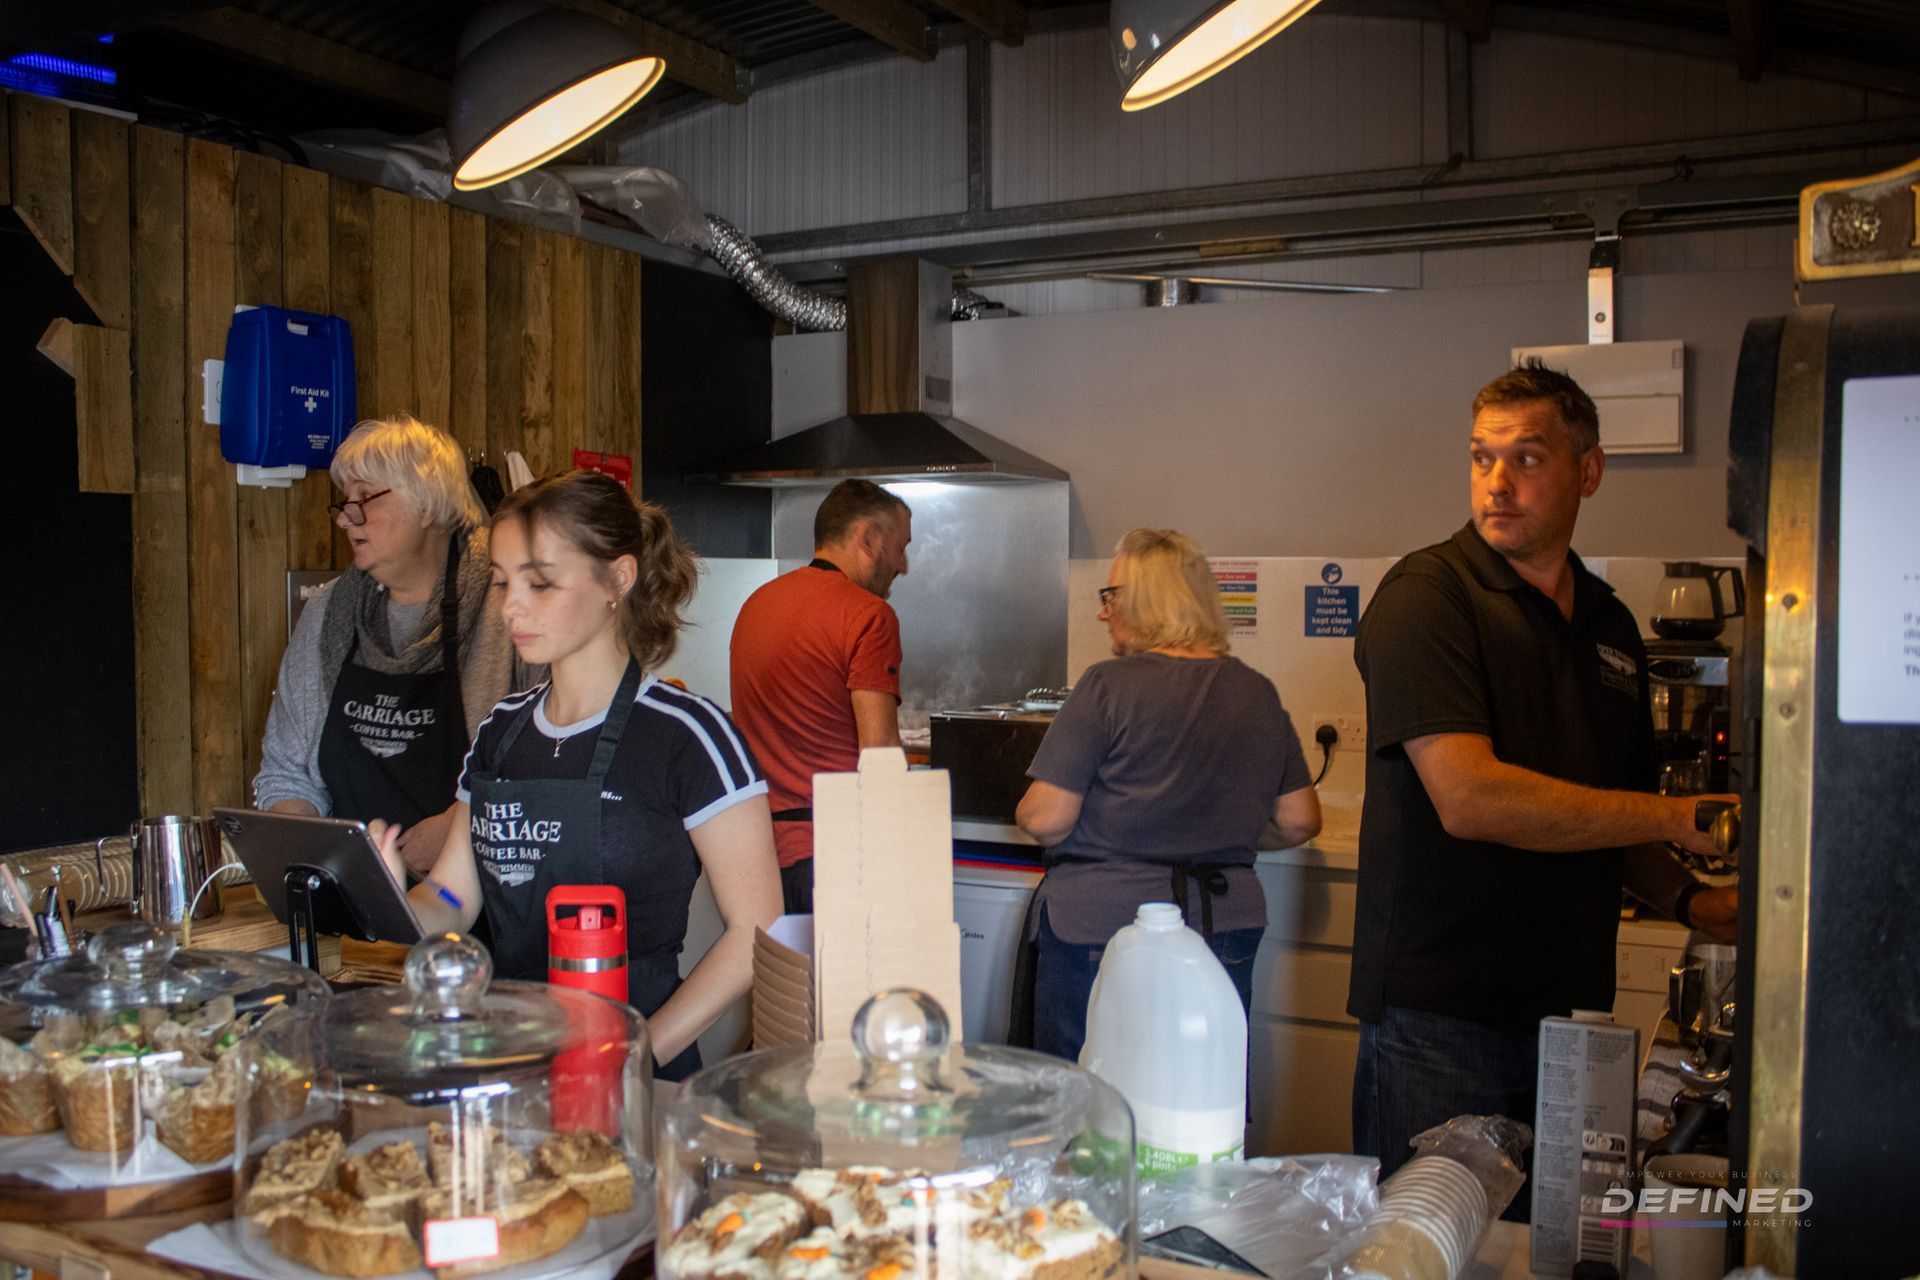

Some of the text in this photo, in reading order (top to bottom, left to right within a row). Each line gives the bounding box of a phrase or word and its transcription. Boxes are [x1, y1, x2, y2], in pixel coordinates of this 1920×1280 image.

[291, 386, 330, 398] First Aid Kit
[1317, 597, 1347, 605] kitchen
[1316, 607, 1348, 615] must be
[1312, 617, 1329, 625] kept
[1316, 626, 1348, 636] and tidy
[375, 694, 400, 708] THE
[343, 700, 436, 726] CARRIAGE
[353, 723, 416, 740] COFFEE BAR
[484, 801, 523, 819] THE
[470, 814, 562, 843] ARRIAGE
[476, 841, 541, 860] COFFEE BAR
